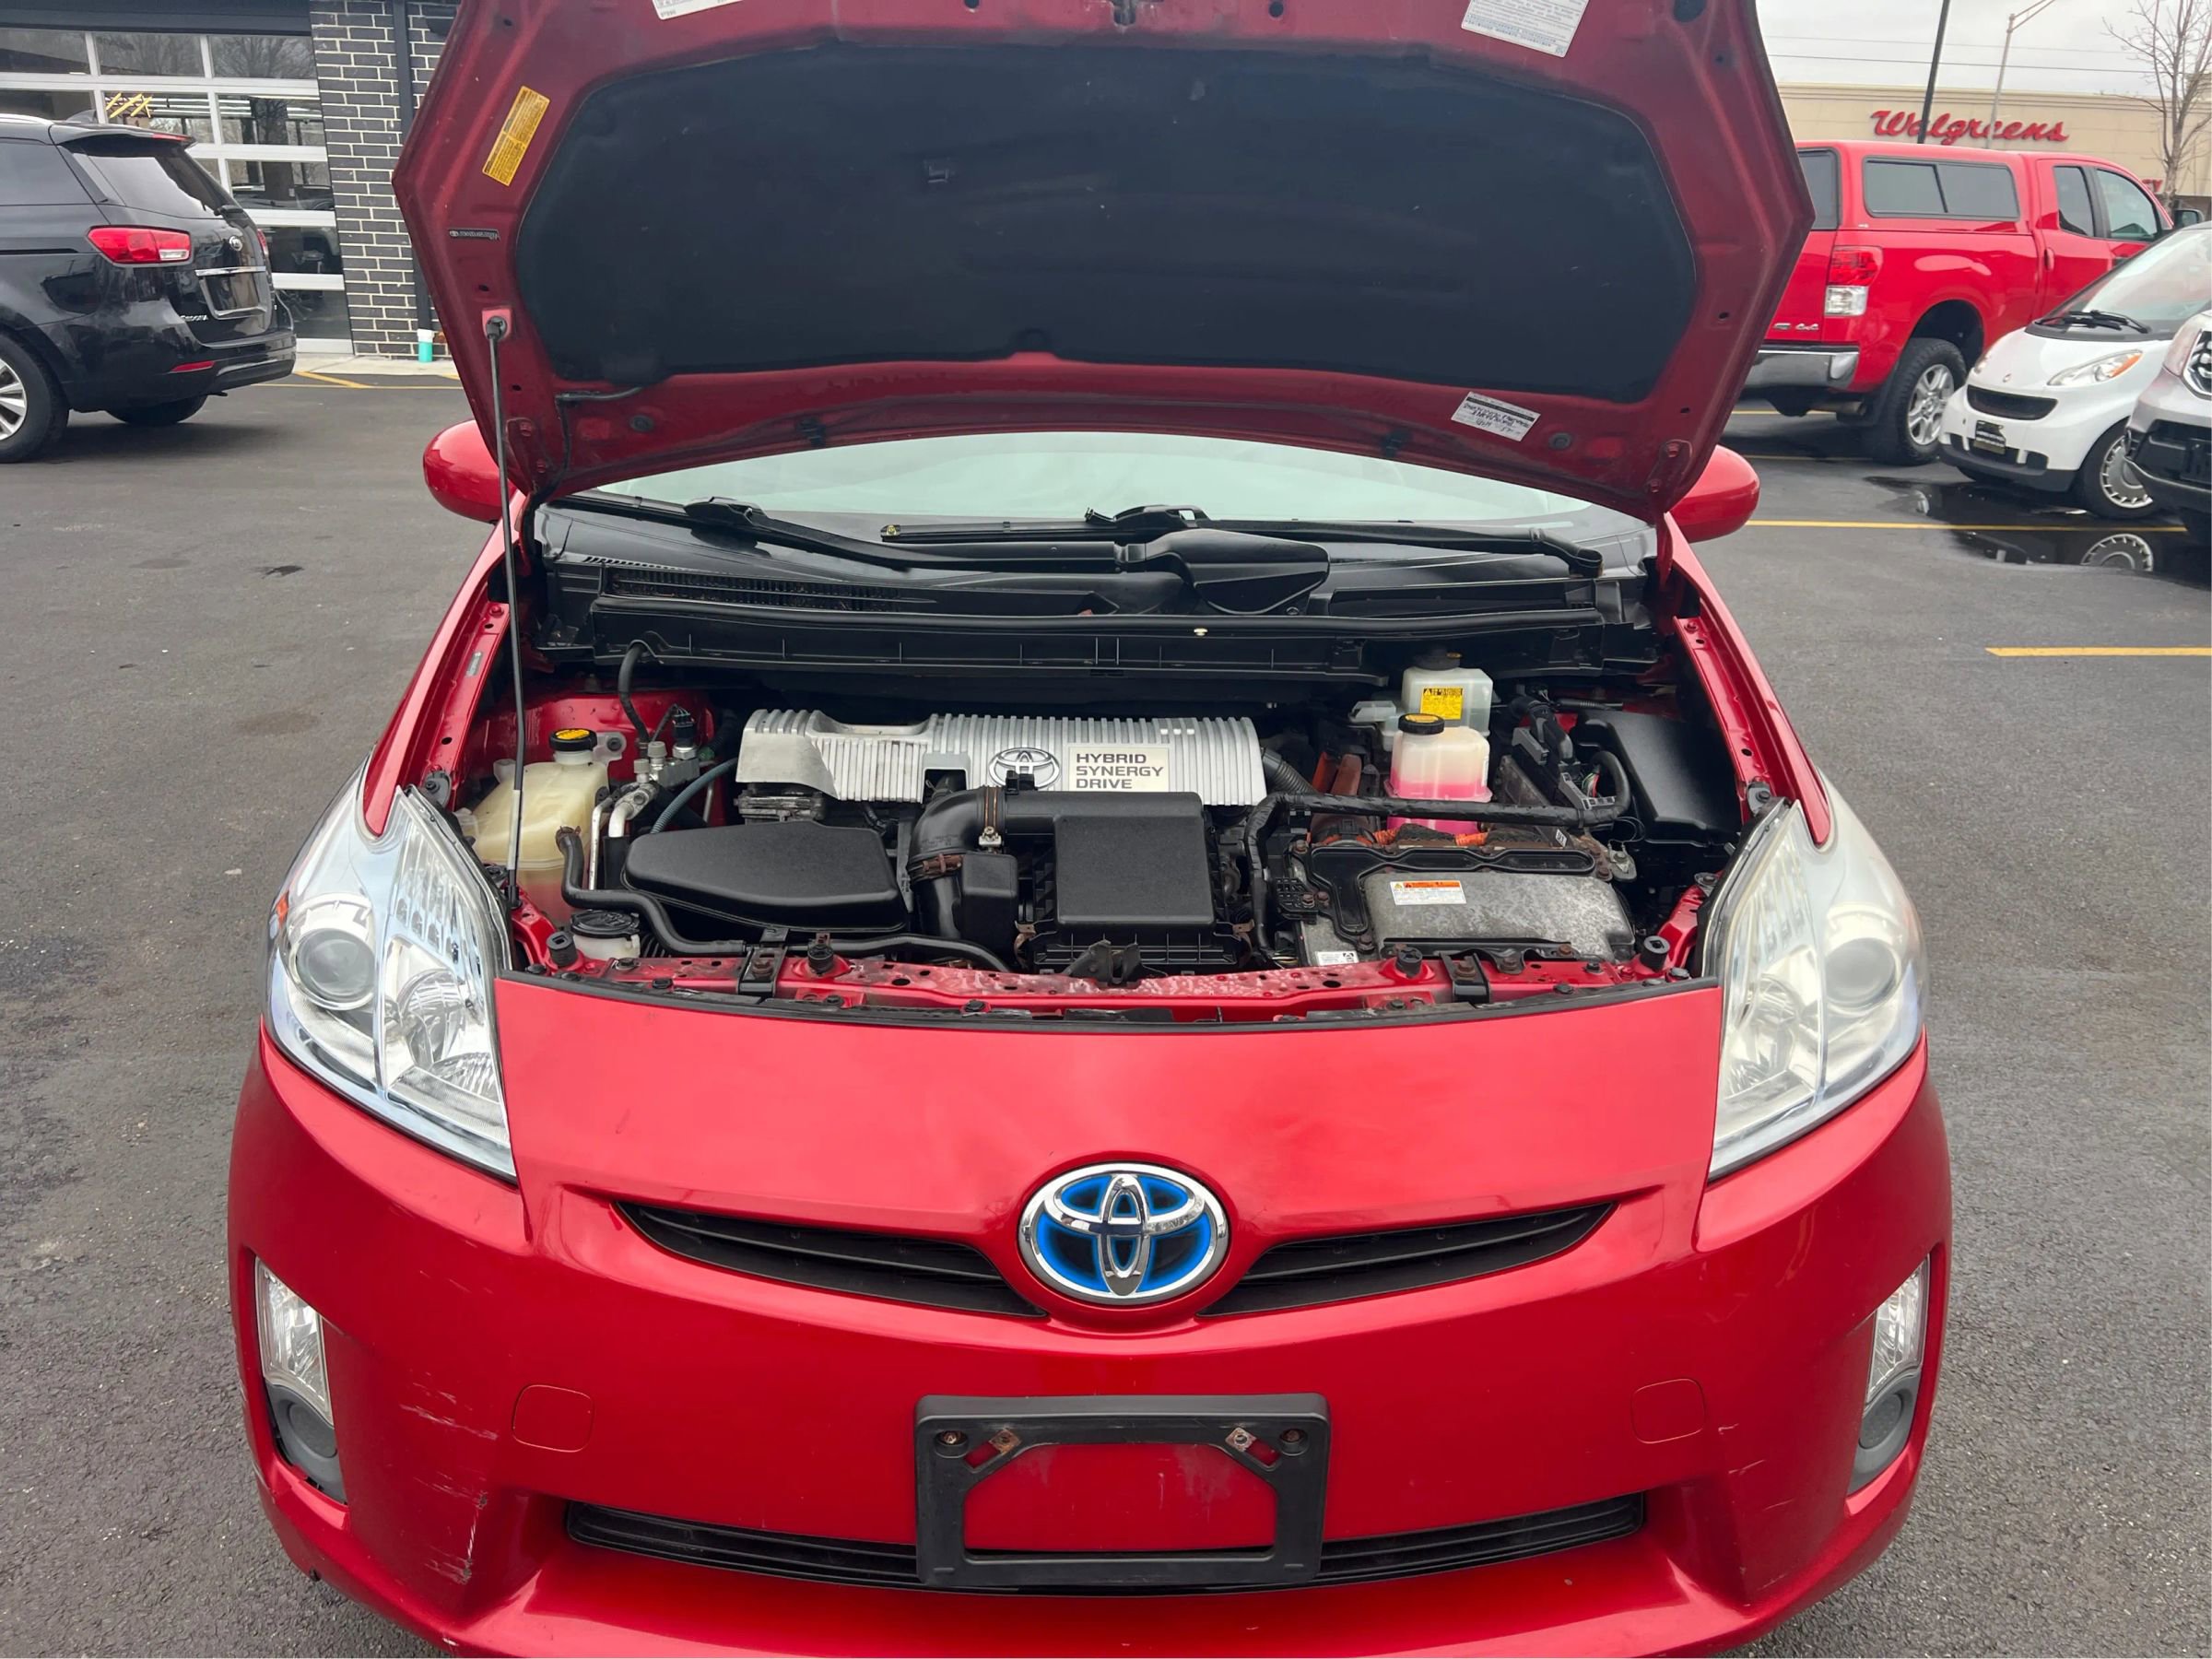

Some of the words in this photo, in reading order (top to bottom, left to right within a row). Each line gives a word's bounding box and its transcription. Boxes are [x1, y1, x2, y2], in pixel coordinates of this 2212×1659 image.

[1871, 110, 2069, 146] Walgreens
[1076, 753, 1147, 764] HYBRID
[1076, 765, 1164, 777] SYNERGY
[1076, 778, 1133, 789] DRIVE
